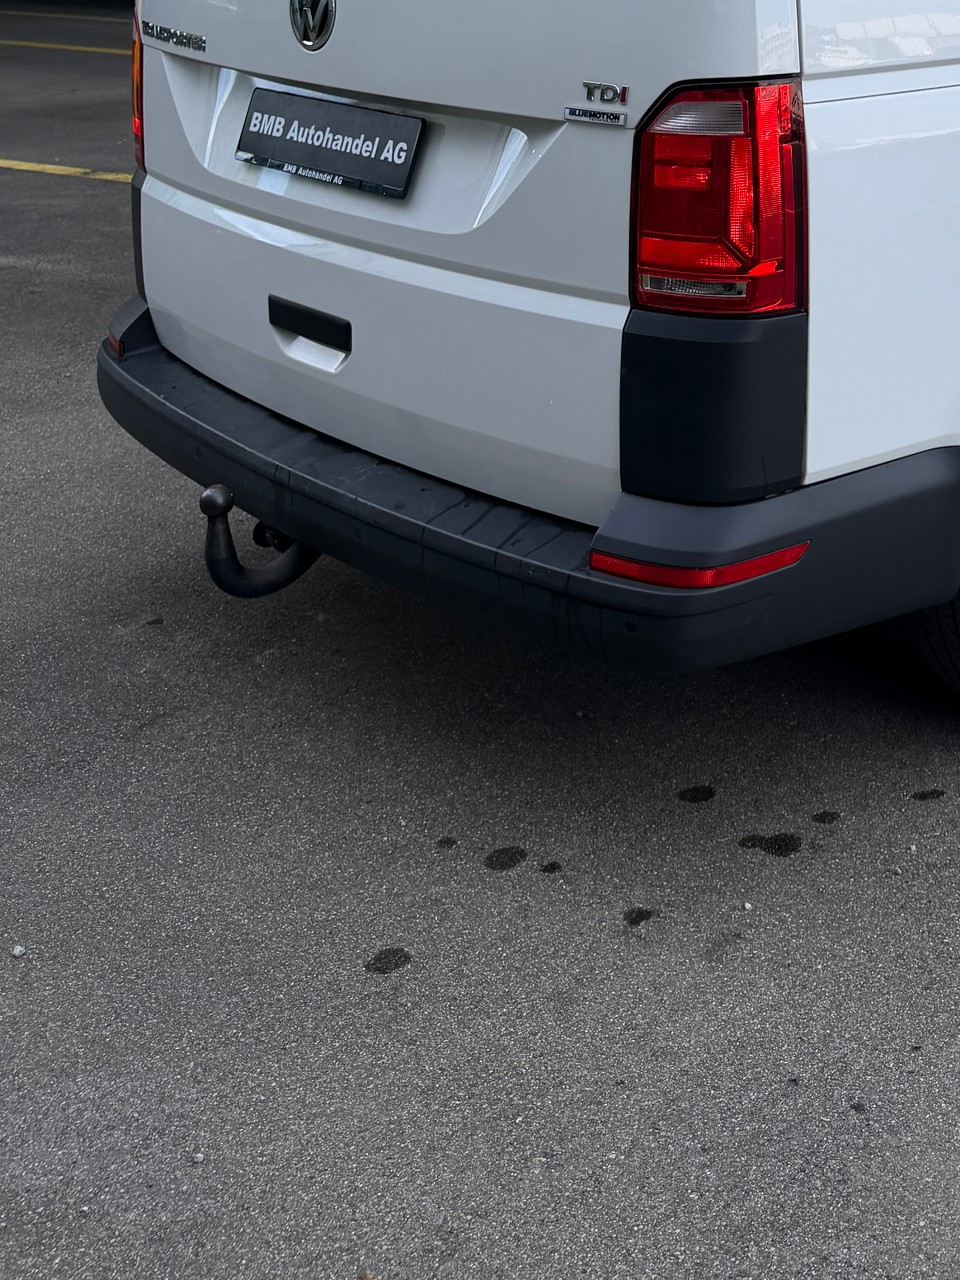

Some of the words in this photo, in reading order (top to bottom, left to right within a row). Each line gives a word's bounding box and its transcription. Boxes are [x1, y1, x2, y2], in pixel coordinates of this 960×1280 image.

[582, 80, 630, 106] TDI
[249, 111, 286, 138] BMB
[285, 120, 380, 158] Autohandel
[380, 139, 408, 165] AG
[282, 162, 298, 174] BMB
[297, 166, 334, 182] Autohandel
[331, 174, 344, 185] AG
